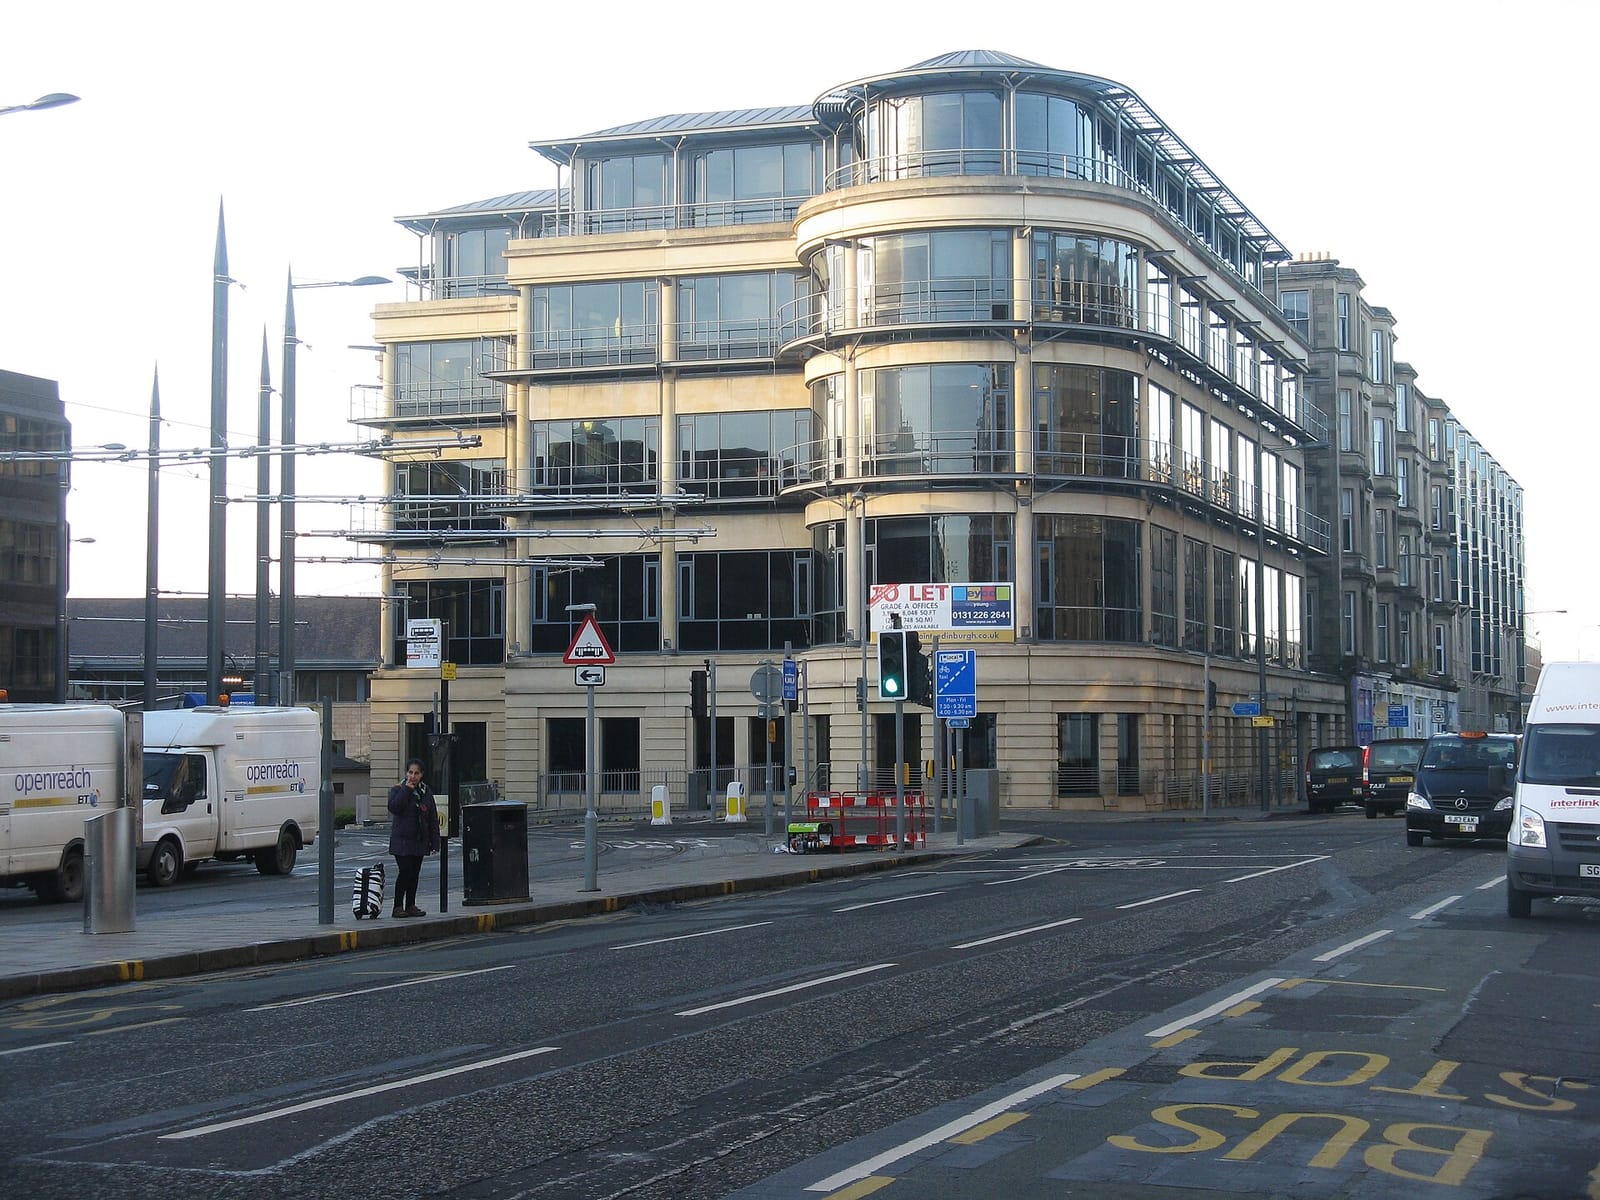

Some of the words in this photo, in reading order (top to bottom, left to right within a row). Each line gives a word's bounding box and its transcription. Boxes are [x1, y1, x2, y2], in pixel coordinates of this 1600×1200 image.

[909, 585, 949, 601] LET
[952, 611, 972, 619] 0131
[973, 611, 989, 619] 226
[990, 611, 1010, 619] 2641
[246, 760, 300, 784] openreach
[14, 767, 91, 796] openreach
[290, 783, 299, 792] BT
[77, 794, 90, 805] BT
[1550, 798, 1600, 808] interlink
[1177, 1047, 1592, 1112] STOP
[1106, 1103, 1494, 1187] BUS
